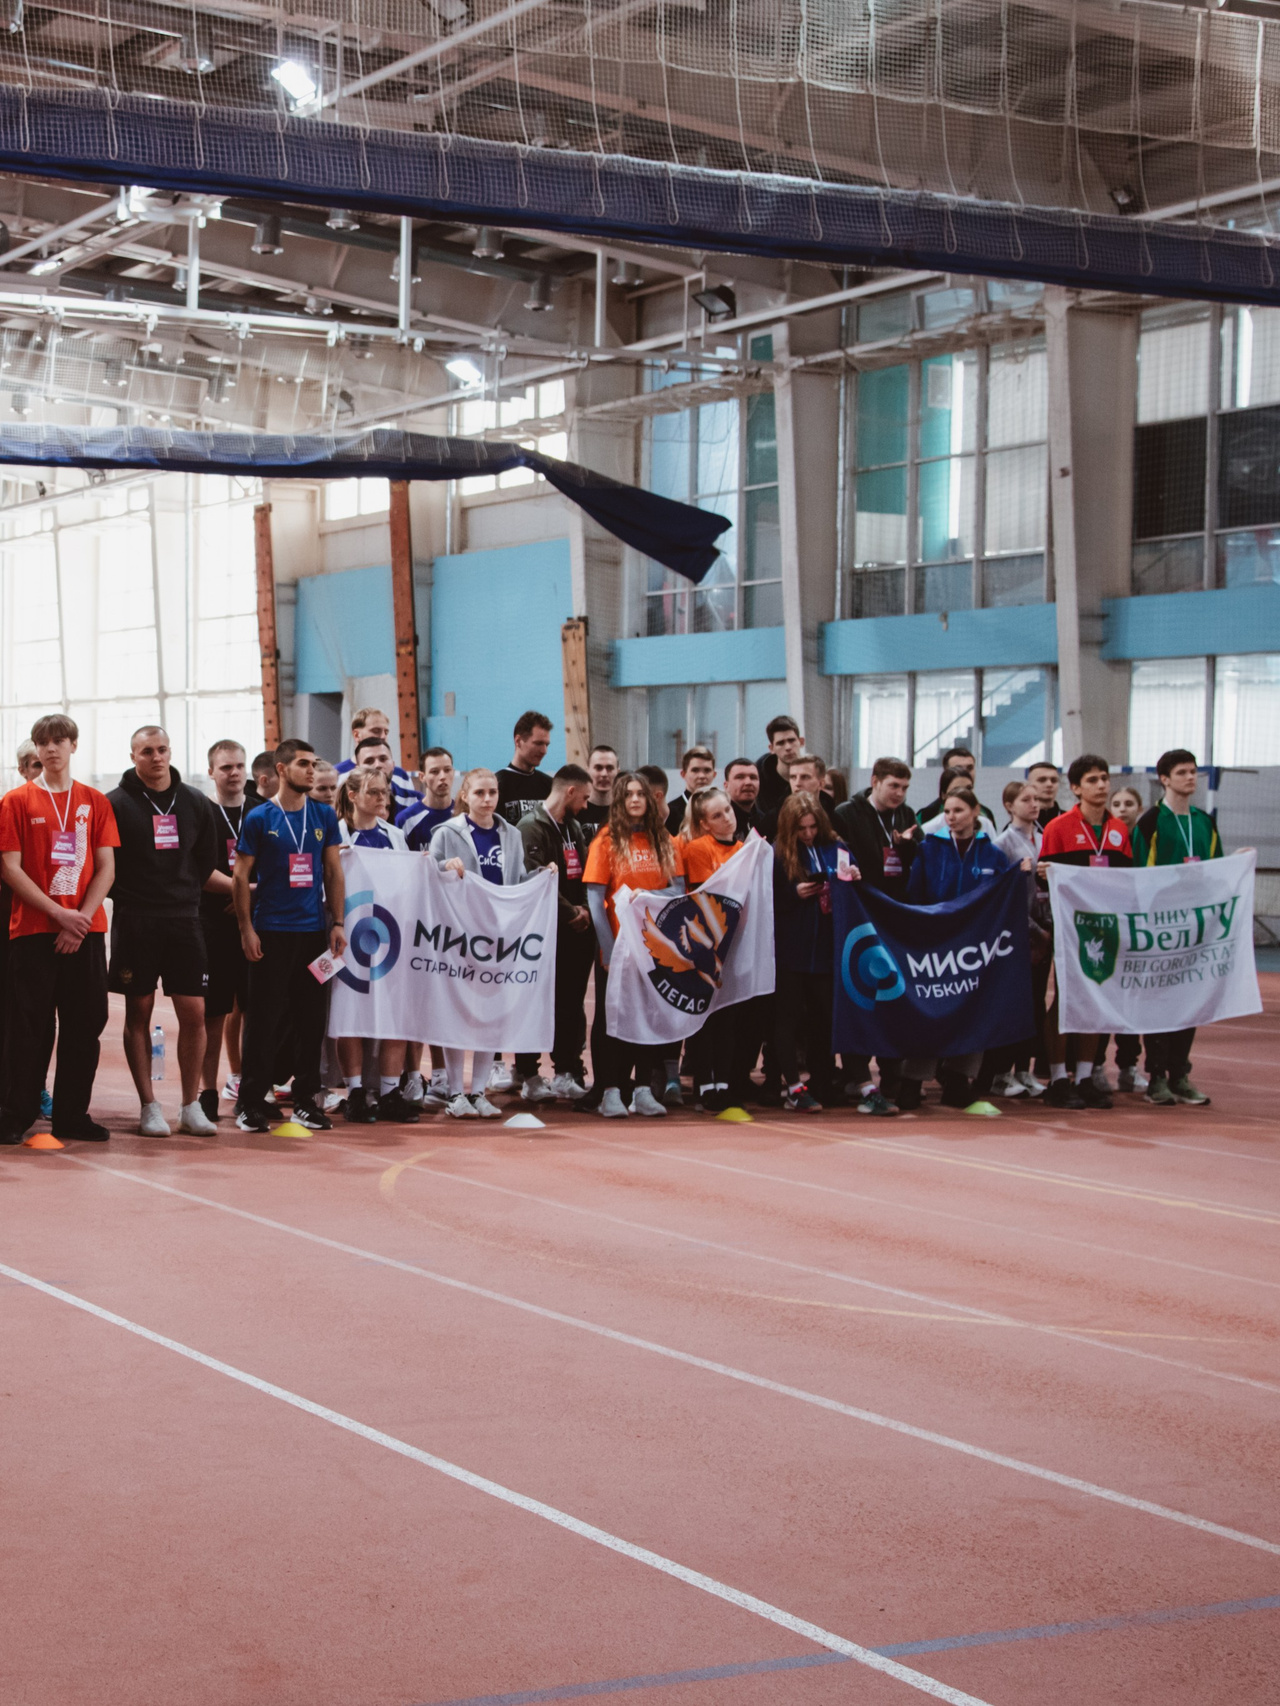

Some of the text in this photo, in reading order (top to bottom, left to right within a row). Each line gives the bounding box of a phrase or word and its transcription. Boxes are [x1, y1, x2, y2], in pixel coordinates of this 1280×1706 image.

[1076, 914, 1116, 928] БелГУ
[1124, 896, 1241, 953] БелГУ
[1154, 909, 1190, 925] НИУ
[413, 919, 544, 963] МИСИС
[906, 930, 1014, 978] МИСИС
[1123, 952, 1197, 973] BELGOROD
[410, 957, 538, 984] СТАРЫЙ ОСКОЛ
[1121, 967, 1205, 989] UNIVERSITY
[657, 978, 706, 1012] ПЕГАС
[915, 976, 980, 998] ГУБКИН
